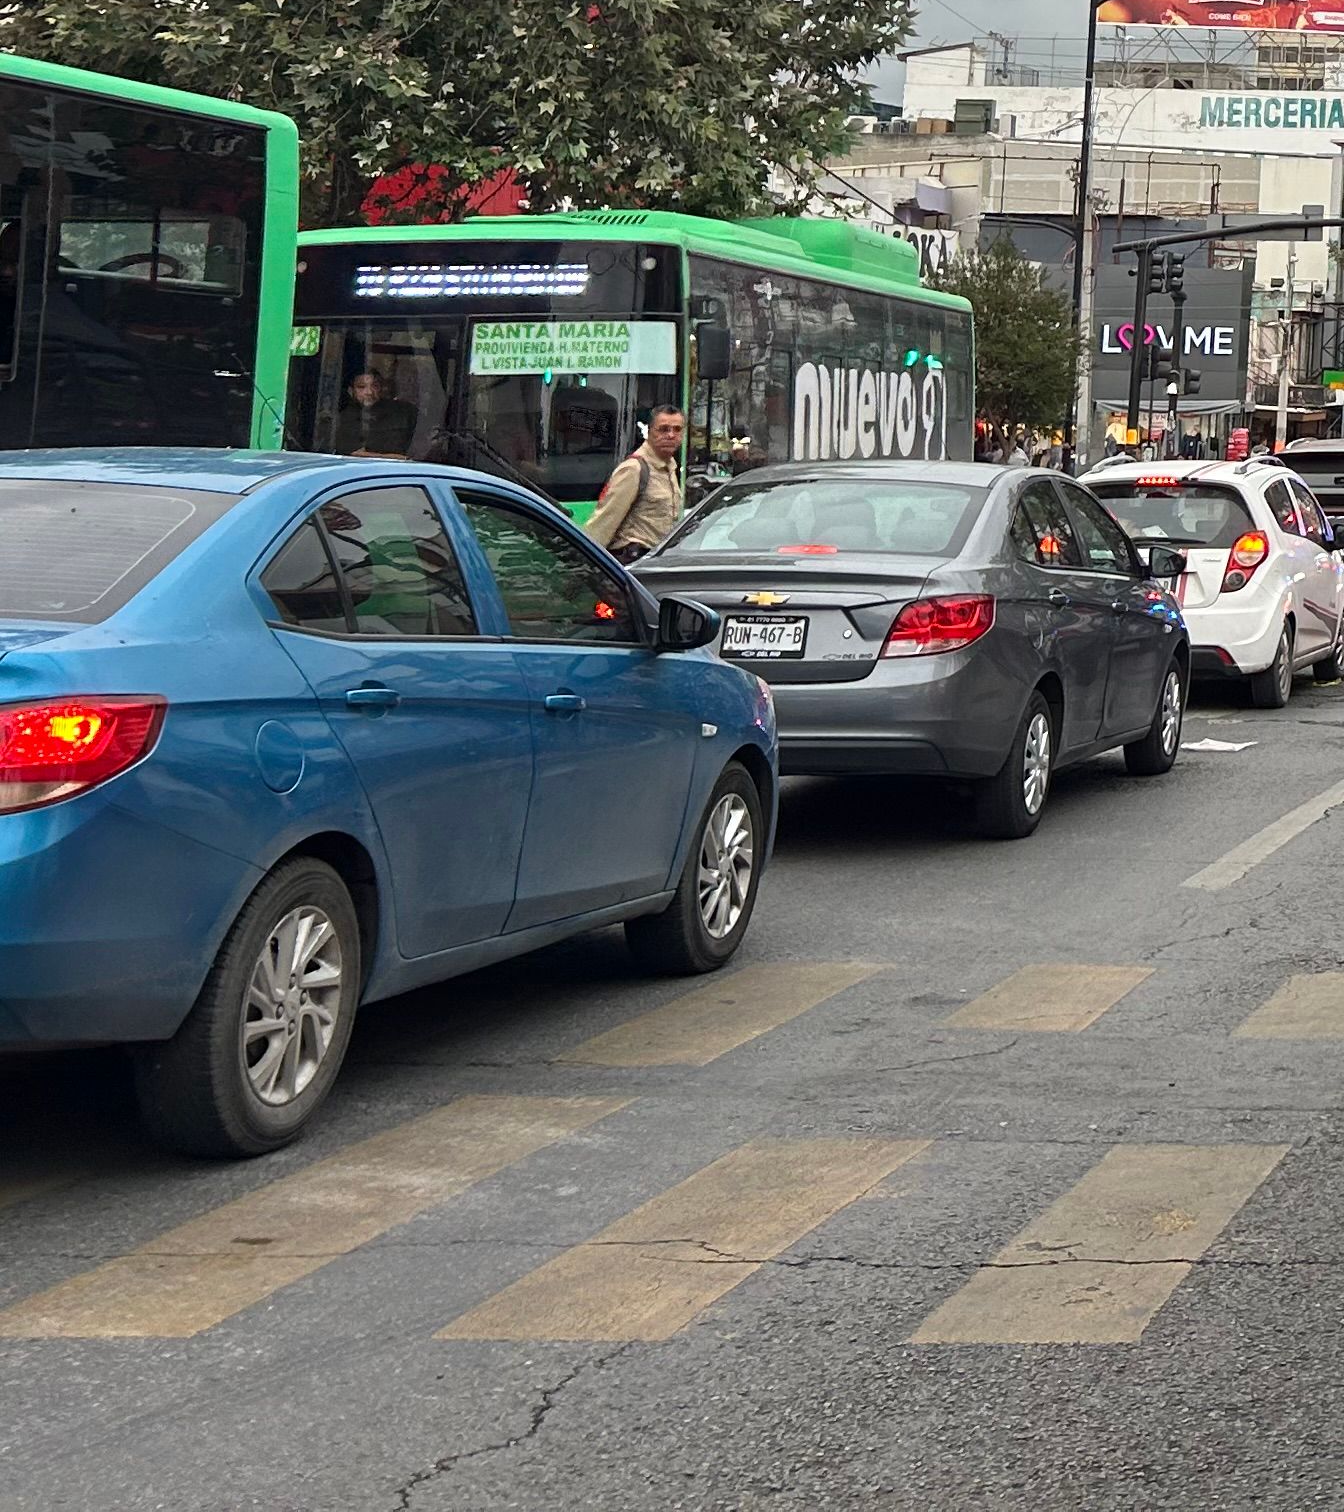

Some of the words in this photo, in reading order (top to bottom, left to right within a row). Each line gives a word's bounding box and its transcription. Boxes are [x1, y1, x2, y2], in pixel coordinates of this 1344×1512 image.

[475, 323, 551, 339] SANTA
[558, 323, 631, 338] MARIA
[1184, 325, 1234, 355] ME
[726, 626, 803, 645] RUN-467-B
